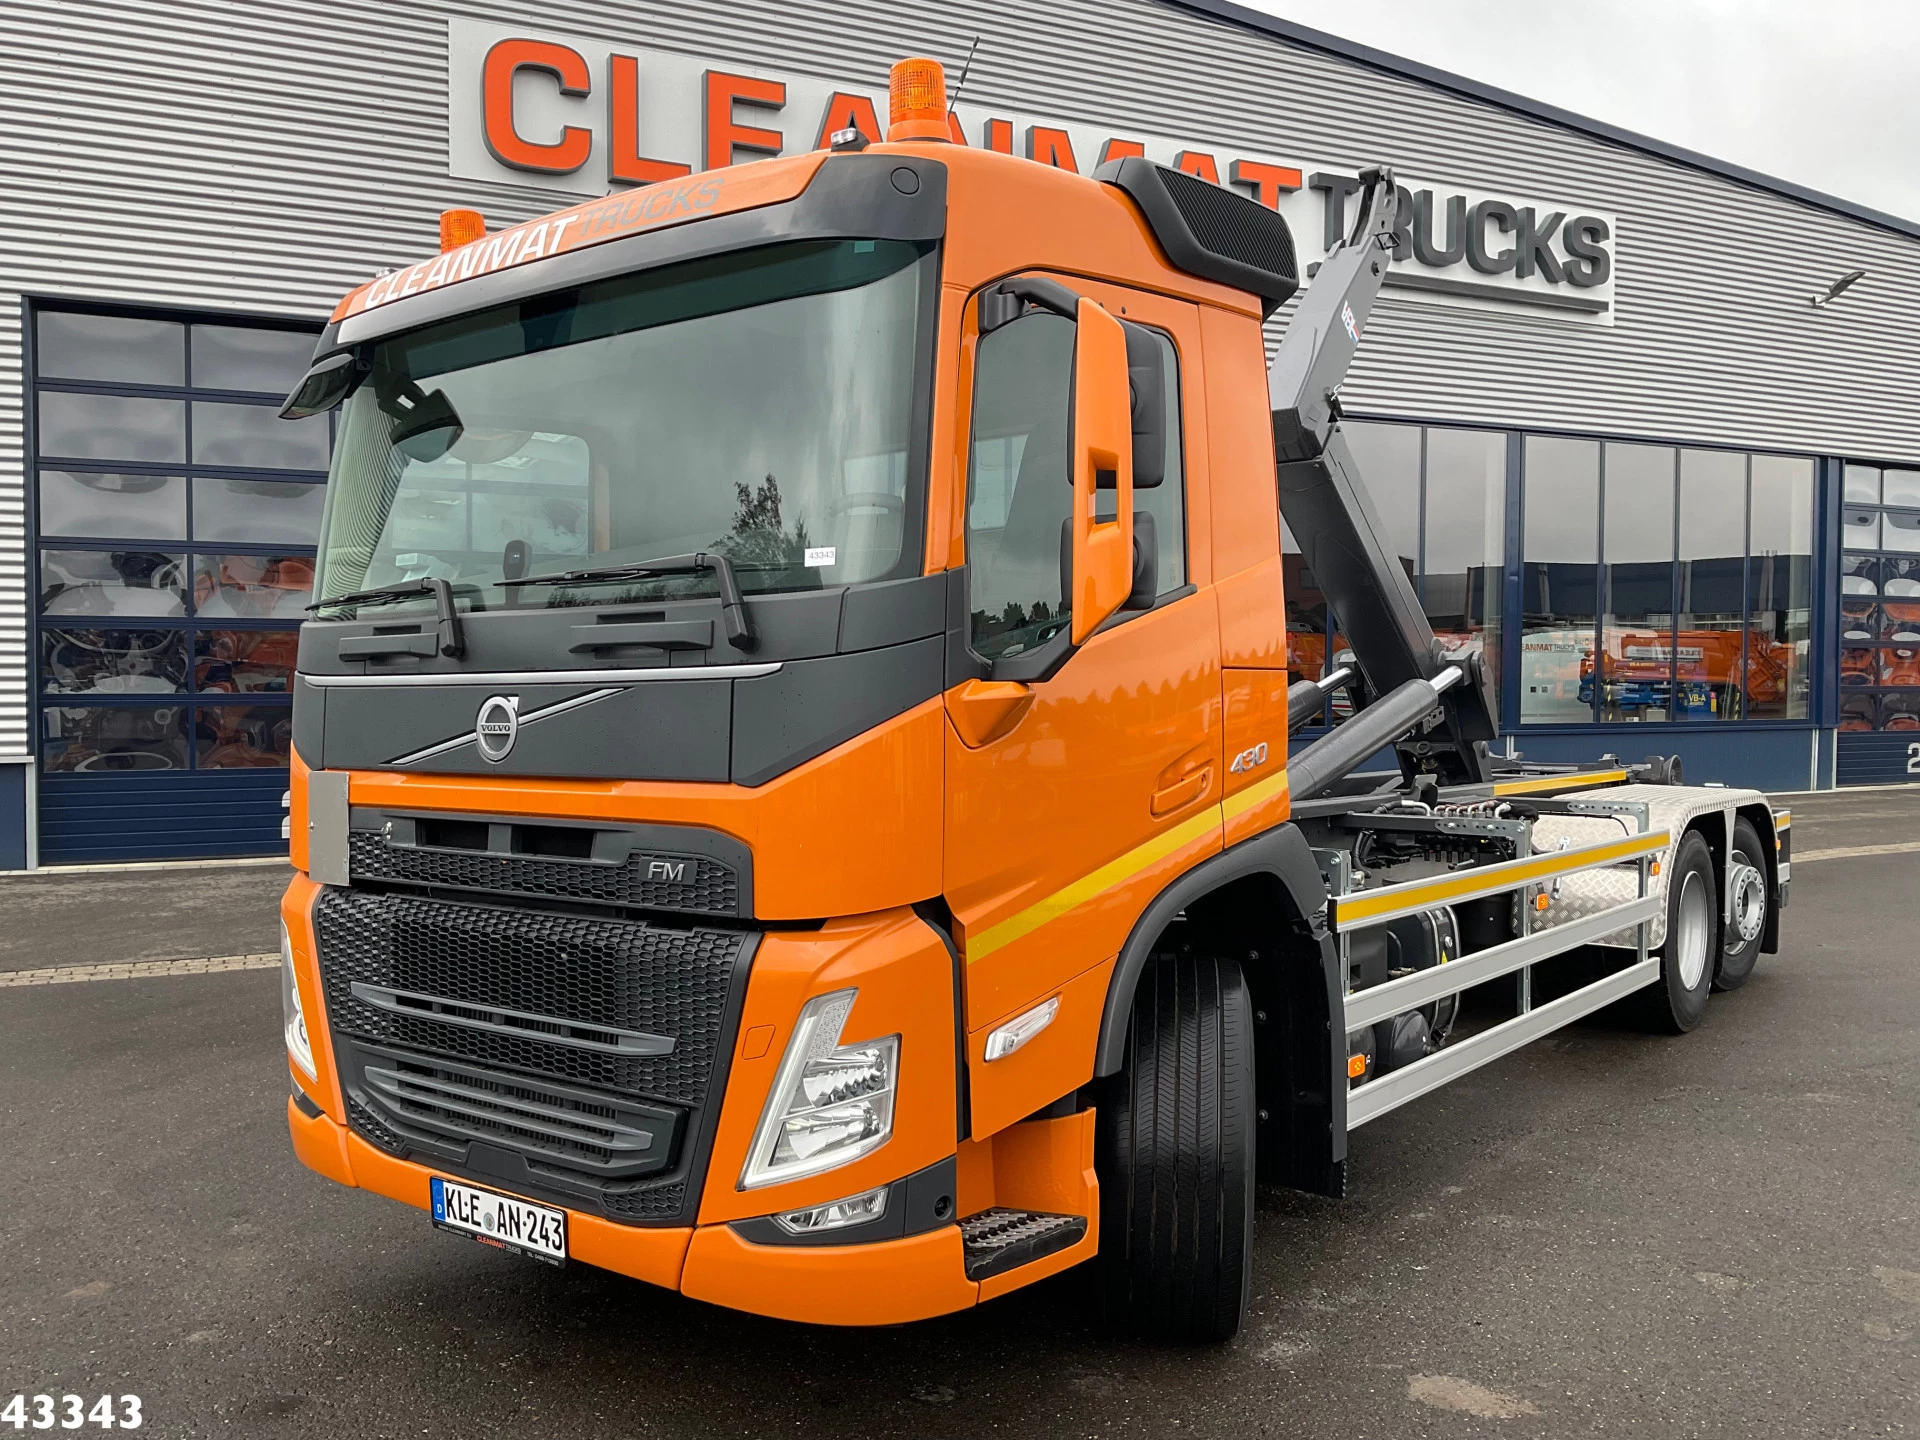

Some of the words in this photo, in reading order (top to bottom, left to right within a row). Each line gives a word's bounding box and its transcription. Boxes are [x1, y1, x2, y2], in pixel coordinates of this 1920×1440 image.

[482, 38, 1303, 212] CLEAT
[364, 215, 579, 309] CLEANMAT
[579, 178, 725, 238] TRUCKS
[809, 551, 834, 559] 43343
[1688, 693, 1707, 702] VB-A
[1229, 742, 1268, 774] 430
[1907, 742, 1920, 773] 2
[647, 861, 685, 881] FM
[437, 1203, 443, 1214] D
